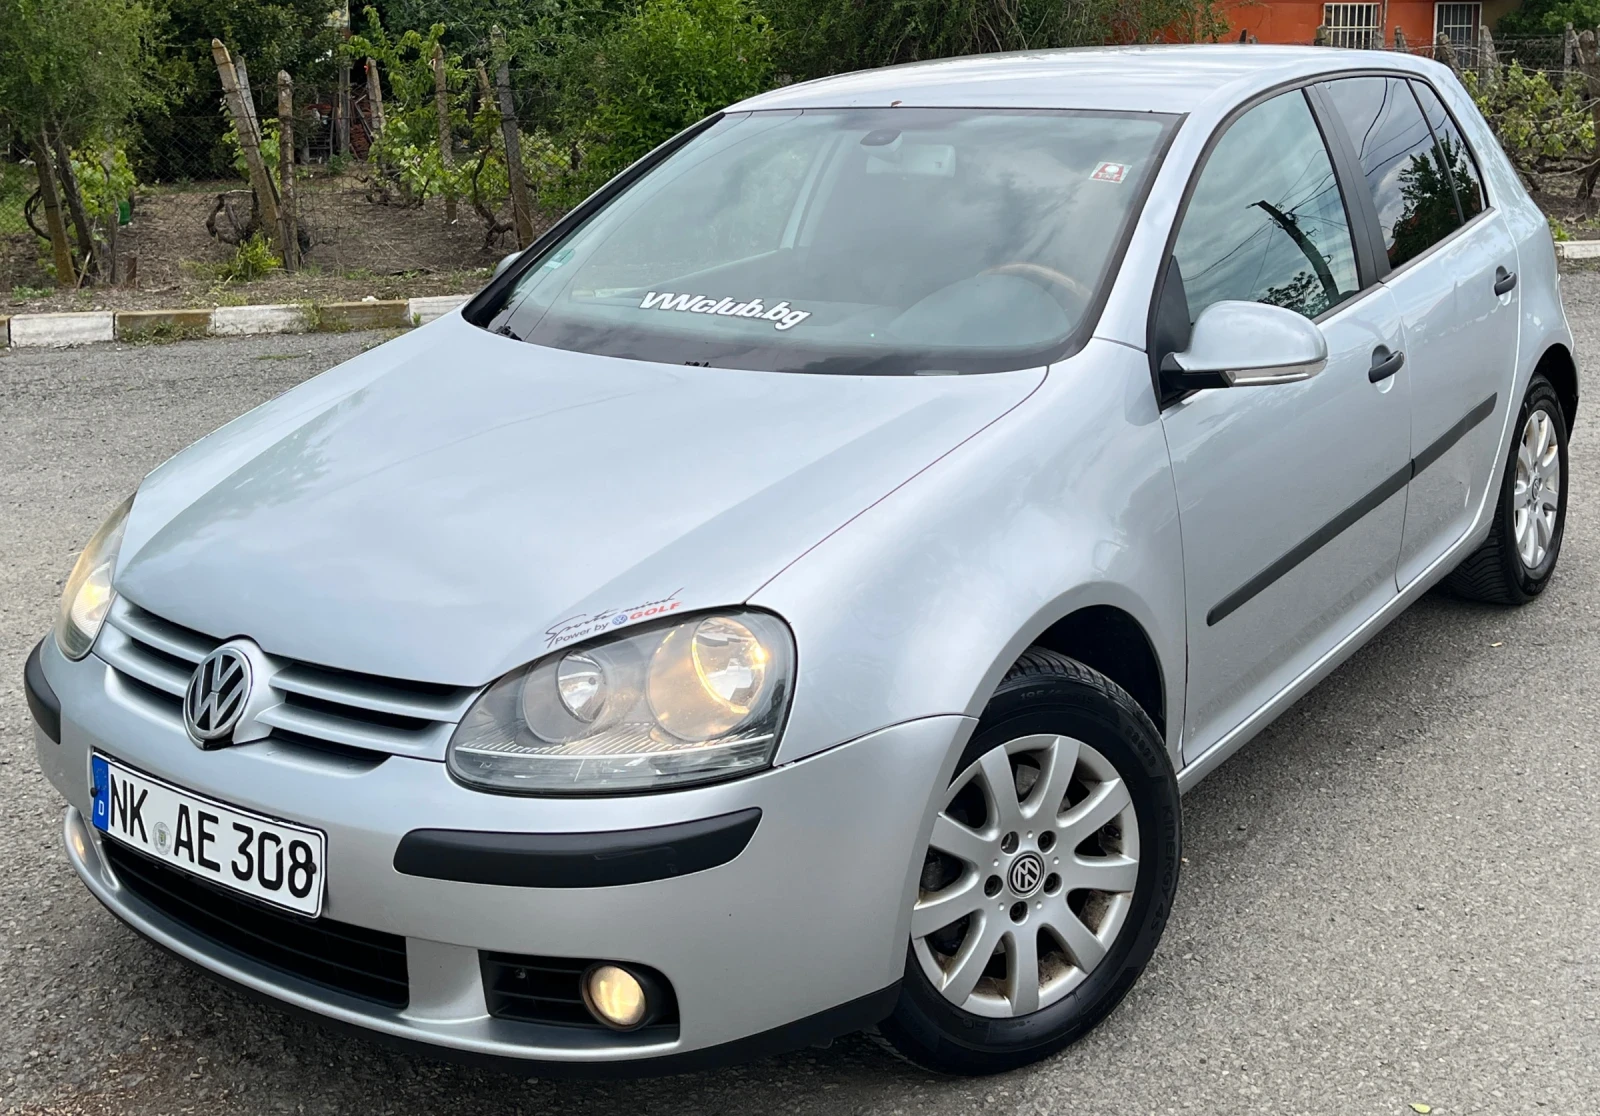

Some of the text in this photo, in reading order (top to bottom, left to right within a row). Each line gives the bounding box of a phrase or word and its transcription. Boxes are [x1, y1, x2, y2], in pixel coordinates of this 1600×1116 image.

[639, 291, 812, 331] VWclub.bg
[554, 627, 590, 645] Power
[594, 621, 610, 633] by
[629, 601, 683, 620] GOLF
[186, 647, 250, 740] VW
[98, 800, 105, 816] D
[110, 773, 315, 899] NK AE 308
